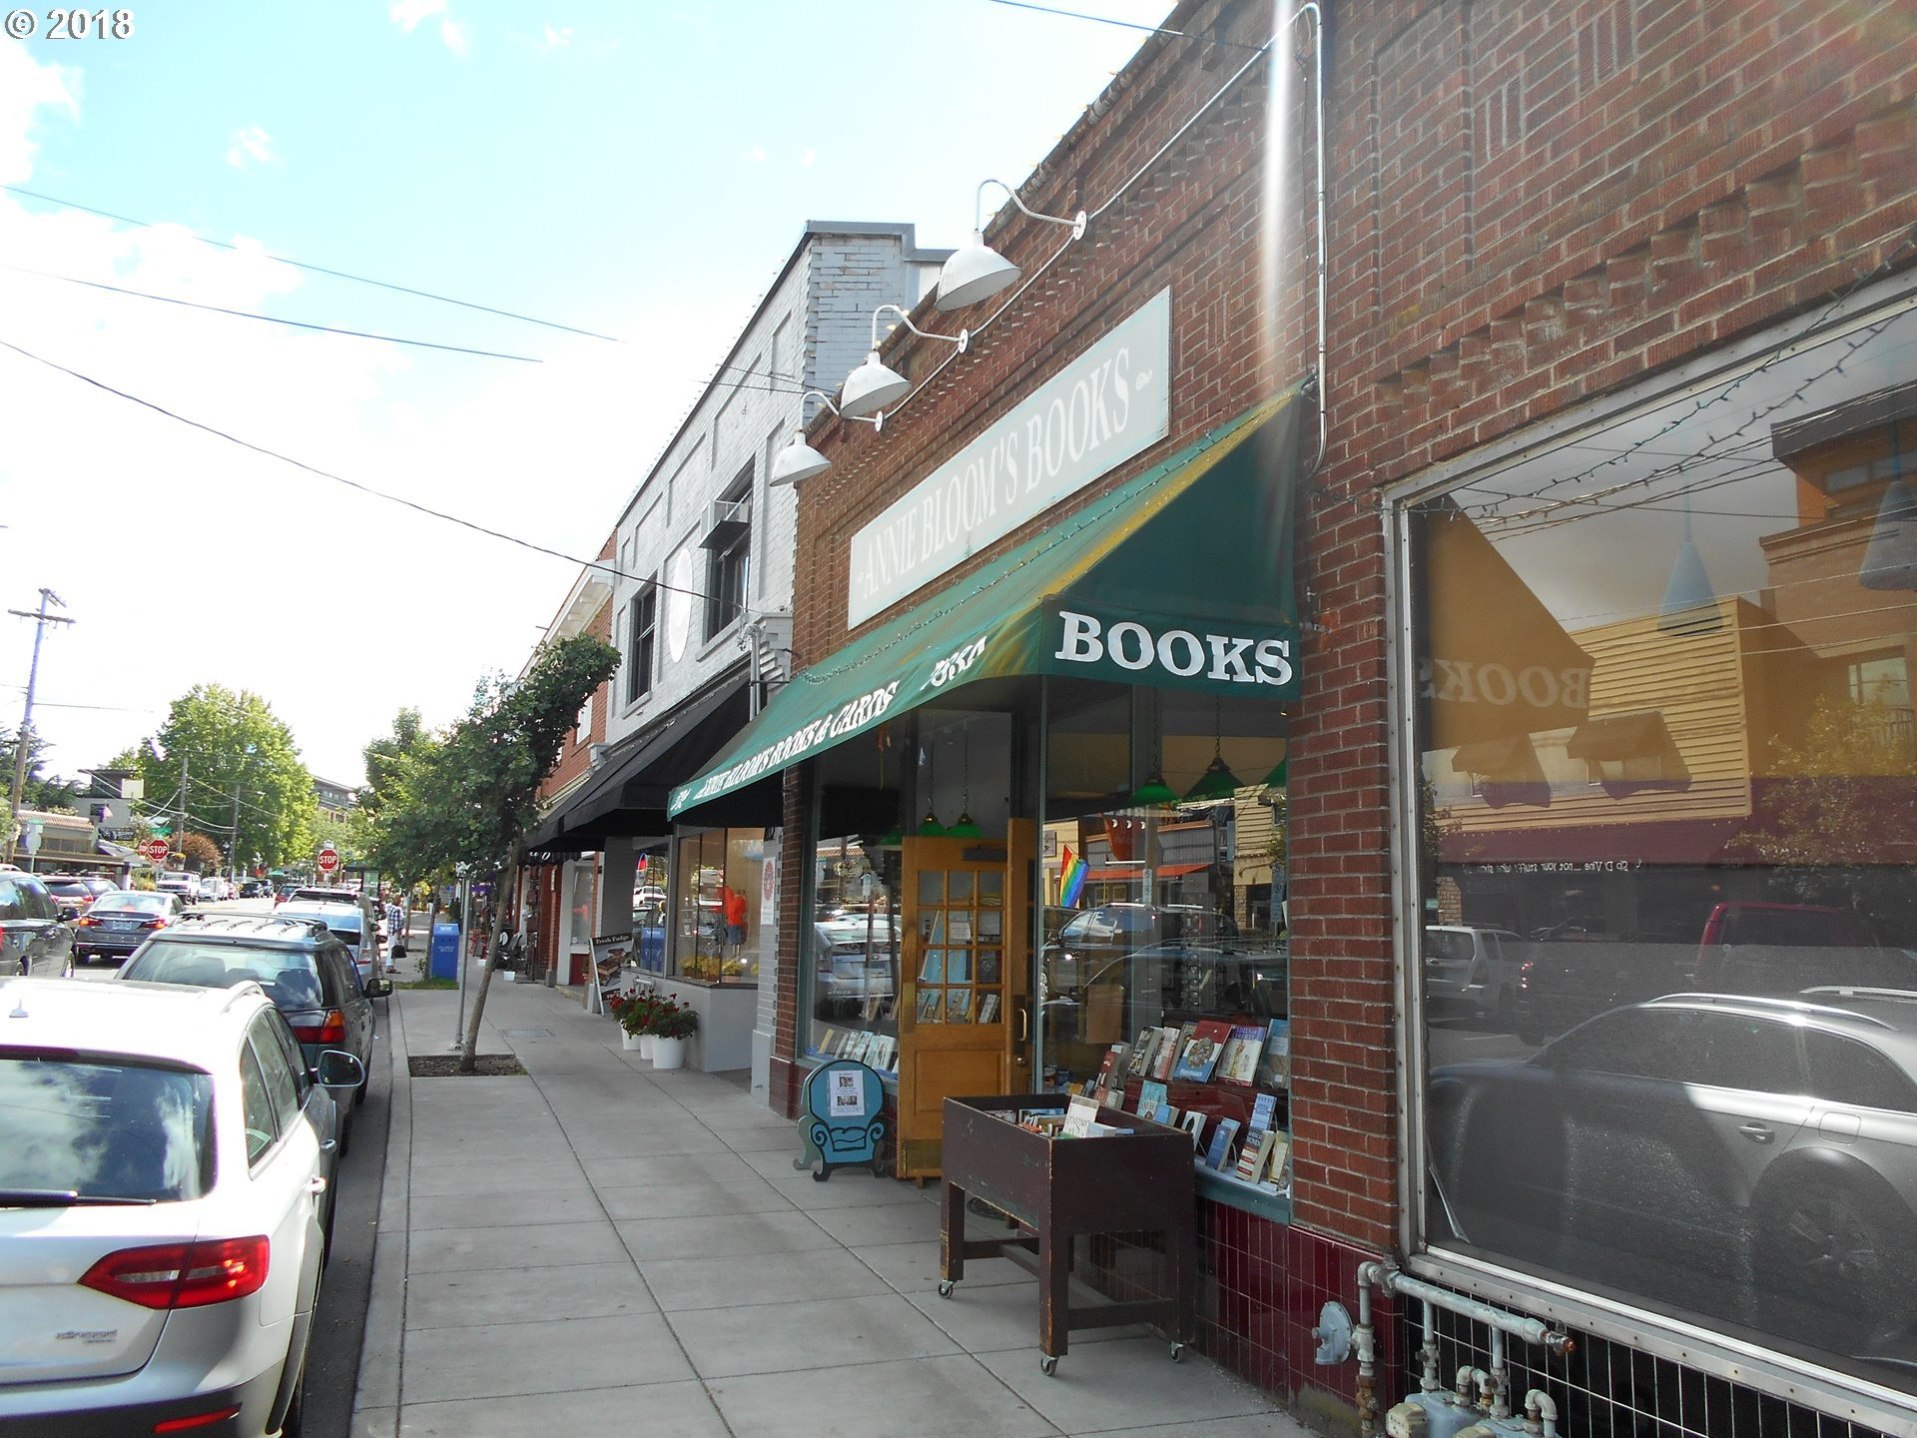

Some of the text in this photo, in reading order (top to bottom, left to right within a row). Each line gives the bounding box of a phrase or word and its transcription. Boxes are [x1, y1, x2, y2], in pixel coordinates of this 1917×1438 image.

[863, 346, 1130, 599] ANNIE BLOOM'S BOOKS
[1055, 610, 1293, 686] BOOKS
[767, 719, 822, 769] BOOKS
[829, 680, 900, 739] CARDS
[149, 845, 168, 854] STOP
[319, 855, 338, 864] STOP
